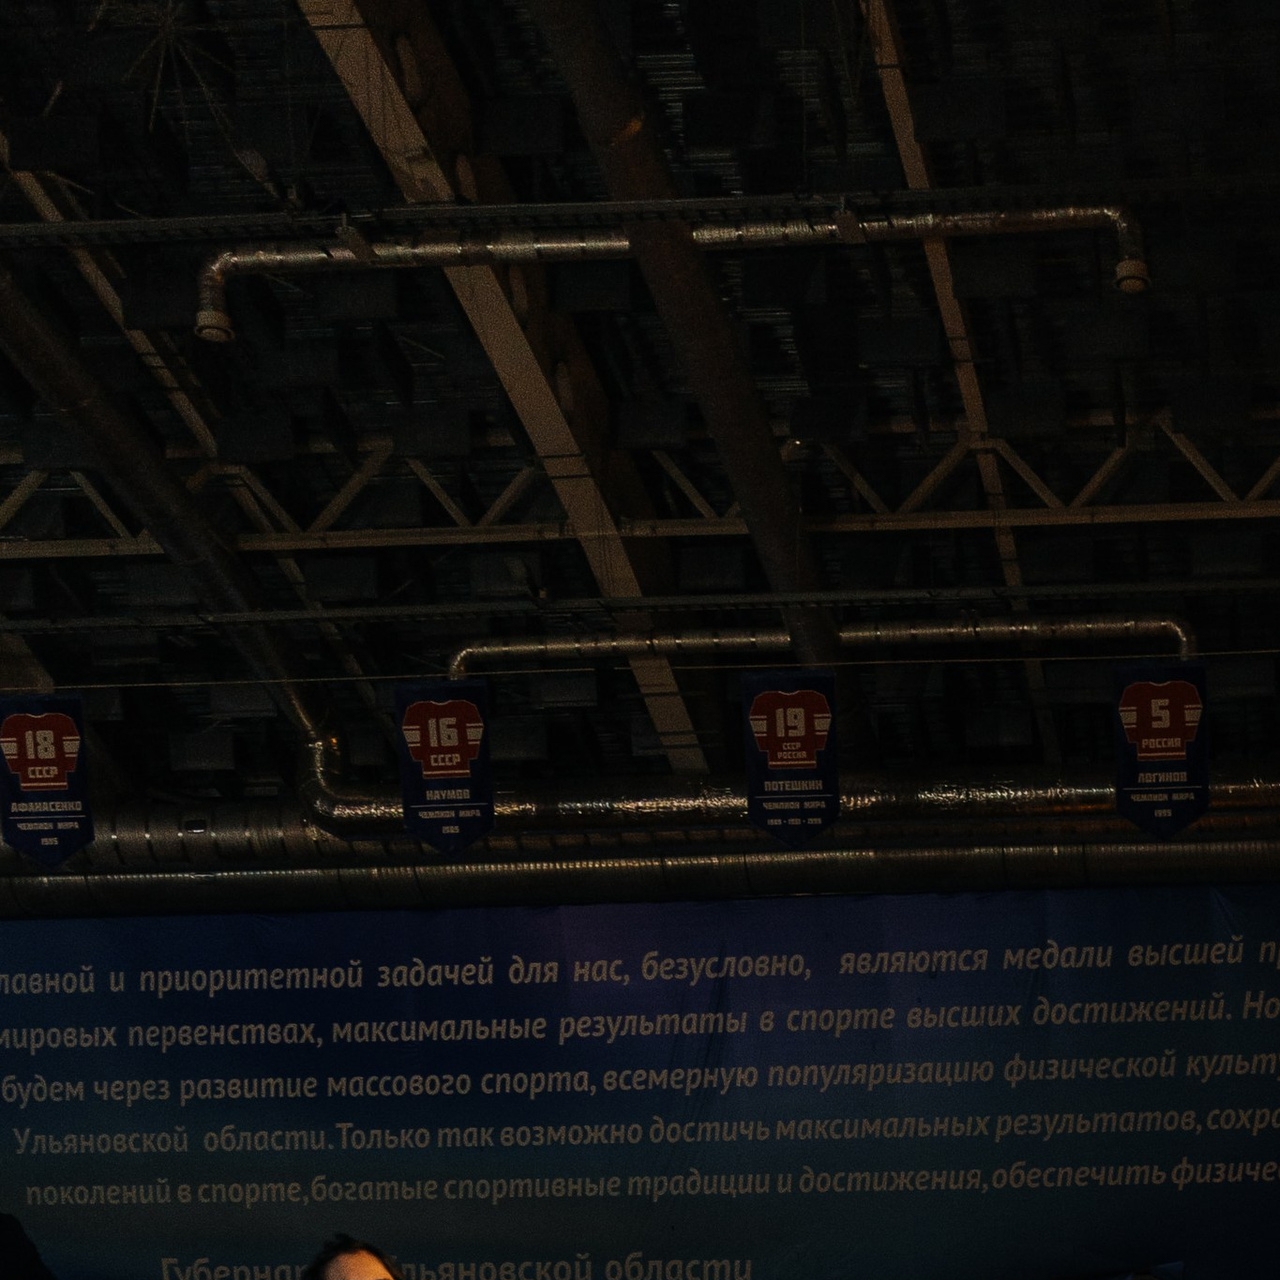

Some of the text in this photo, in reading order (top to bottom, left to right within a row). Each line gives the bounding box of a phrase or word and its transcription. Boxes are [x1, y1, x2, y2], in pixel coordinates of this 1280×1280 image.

[775, 707, 806, 737] 19
[1151, 699, 1171, 729] 5
[25, 730, 56, 760] 18
[427, 716, 459, 748] 16
[1141, 737, 1182, 749] РОССИЯ
[27, 766, 58, 779] СССР
[429, 753, 461, 766] СССР
[109, 971, 125, 993] и
[140, 959, 363, 999] приоритетной
[377, 955, 494, 988] задачей
[508, 954, 559, 985] для
[573, 959, 630, 986] нас,
[641, 950, 811, 987] безусловно,
[839, 949, 988, 974] являются
[1003, 938, 1113, 970] медали
[1127, 934, 1244, 967] высшей
[128, 1022, 324, 1053] первенствах,
[332, 1017, 547, 1043] максимальные
[558, 1012, 748, 1046] результаты
[759, 1010, 775, 1032] в
[787, 1007, 896, 1038] спорте
[907, 1005, 1022, 1028] высших
[1033, 992, 1232, 1025] достижений.
[1242, 990, 1280, 1019] Но
[2, 1074, 84, 1109] будем
[93, 1079, 170, 1107] через
[180, 1076, 318, 1106] развитие
[327, 1073, 472, 1097] массового
[768, 1061, 994, 1092] популяризацию
[1004, 1049, 1176, 1088] физической
[13, 1126, 188, 1154] Ульяновской
[437, 1127, 494, 1147] так
[500, 1123, 643, 1147] возможно
[649, 1115, 770, 1143] достичь
[776, 1116, 990, 1140] максимальных
[26, 1178, 171, 1205] поколений
[177, 1184, 192, 1203] в
[443, 1176, 621, 1205] спортивные
[628, 1168, 770, 1202] традиции
[777, 1174, 792, 1194] и
